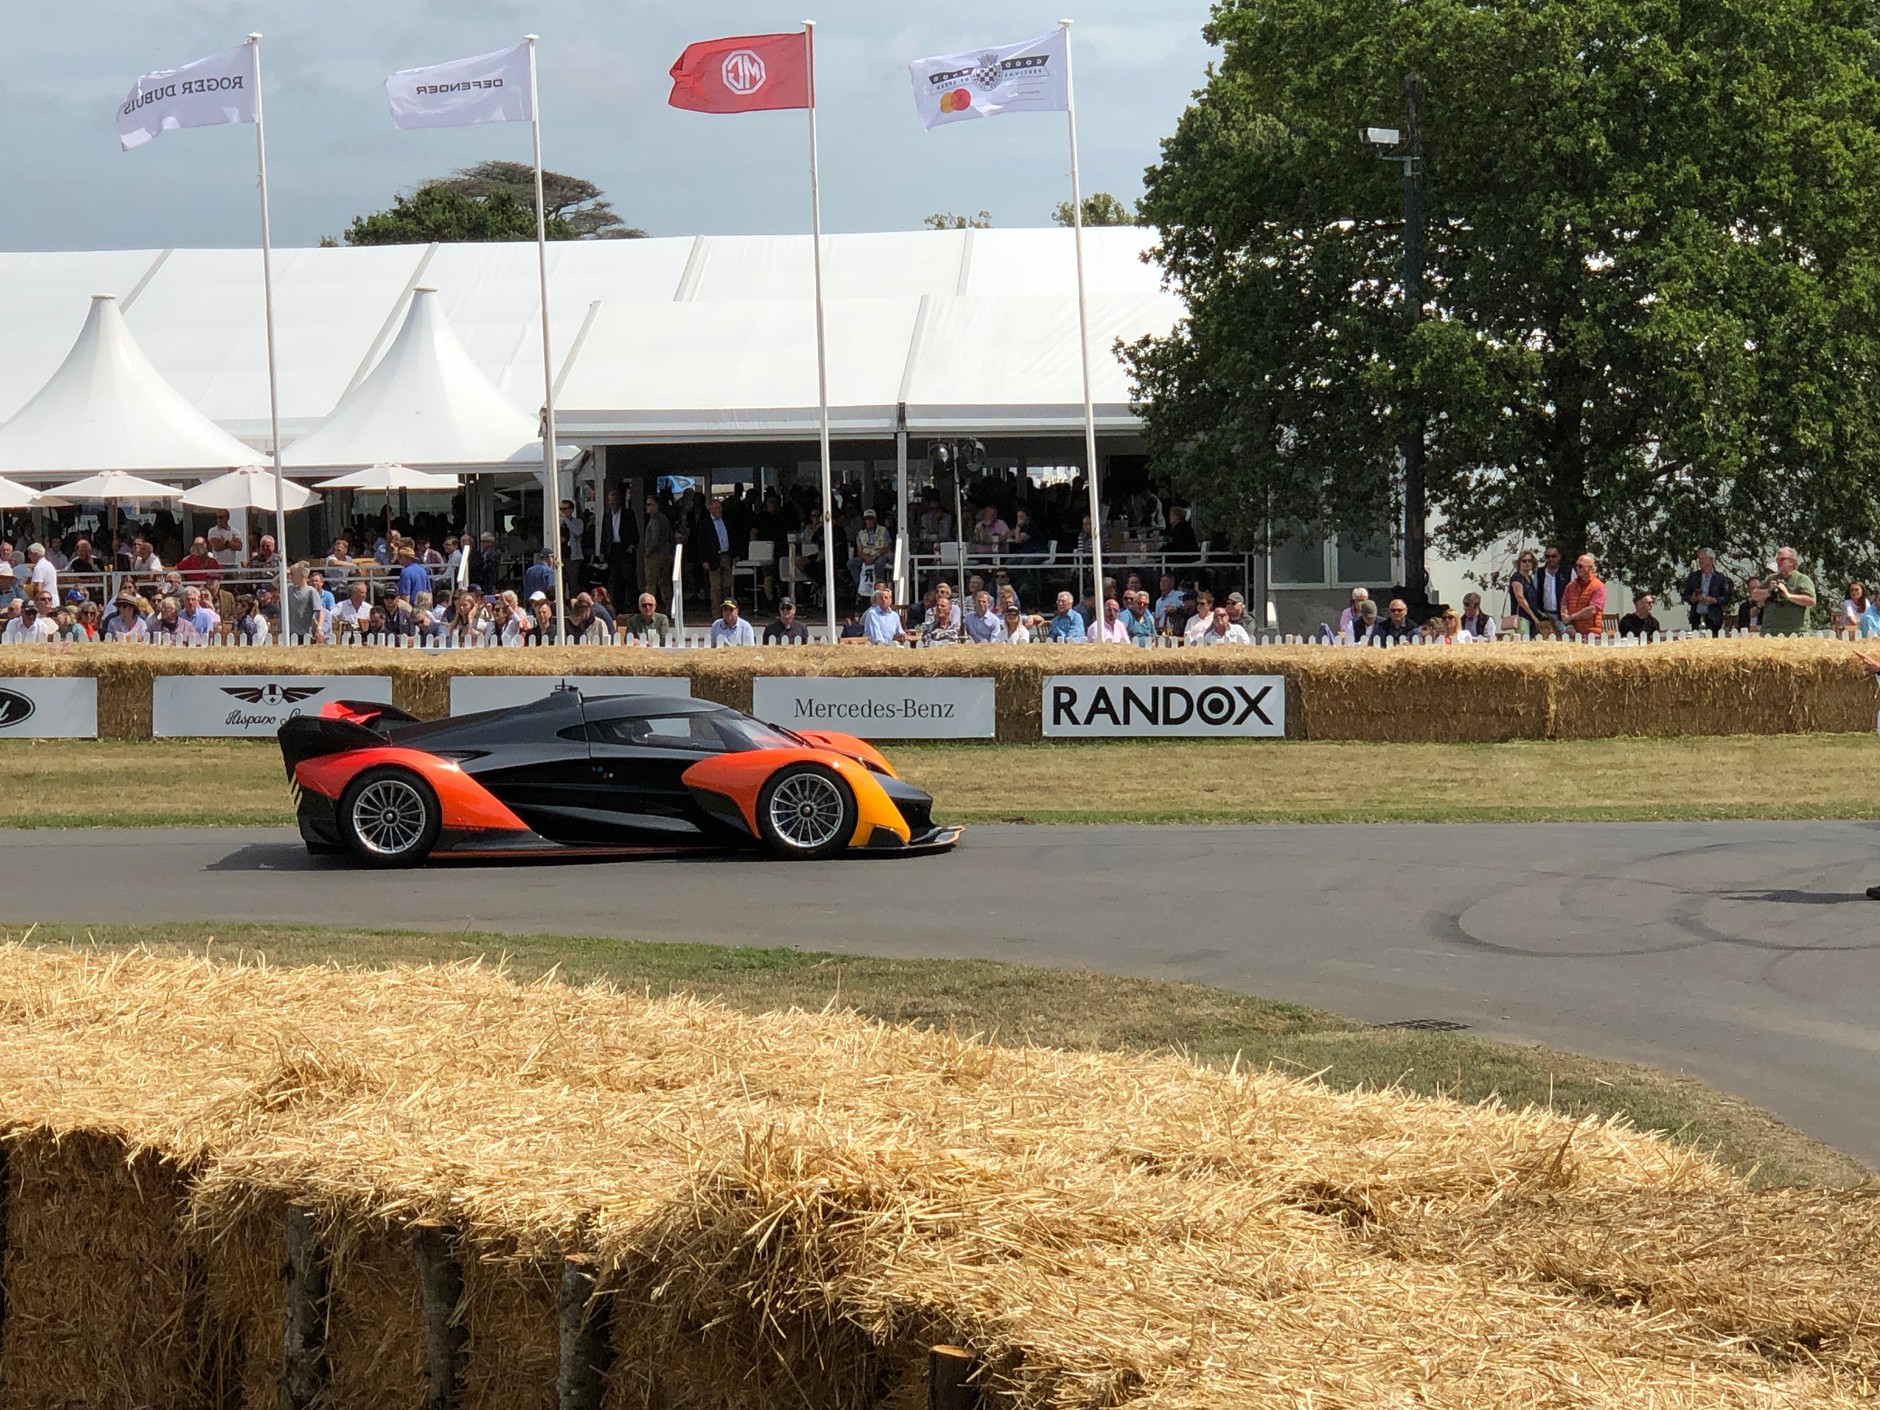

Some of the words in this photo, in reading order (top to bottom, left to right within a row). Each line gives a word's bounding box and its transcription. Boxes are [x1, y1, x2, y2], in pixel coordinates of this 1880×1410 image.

[794, 697, 955, 718] Mercedes-Benz
[1052, 685, 1274, 726] RANDOX
[225, 708, 276, 730] Hispano
